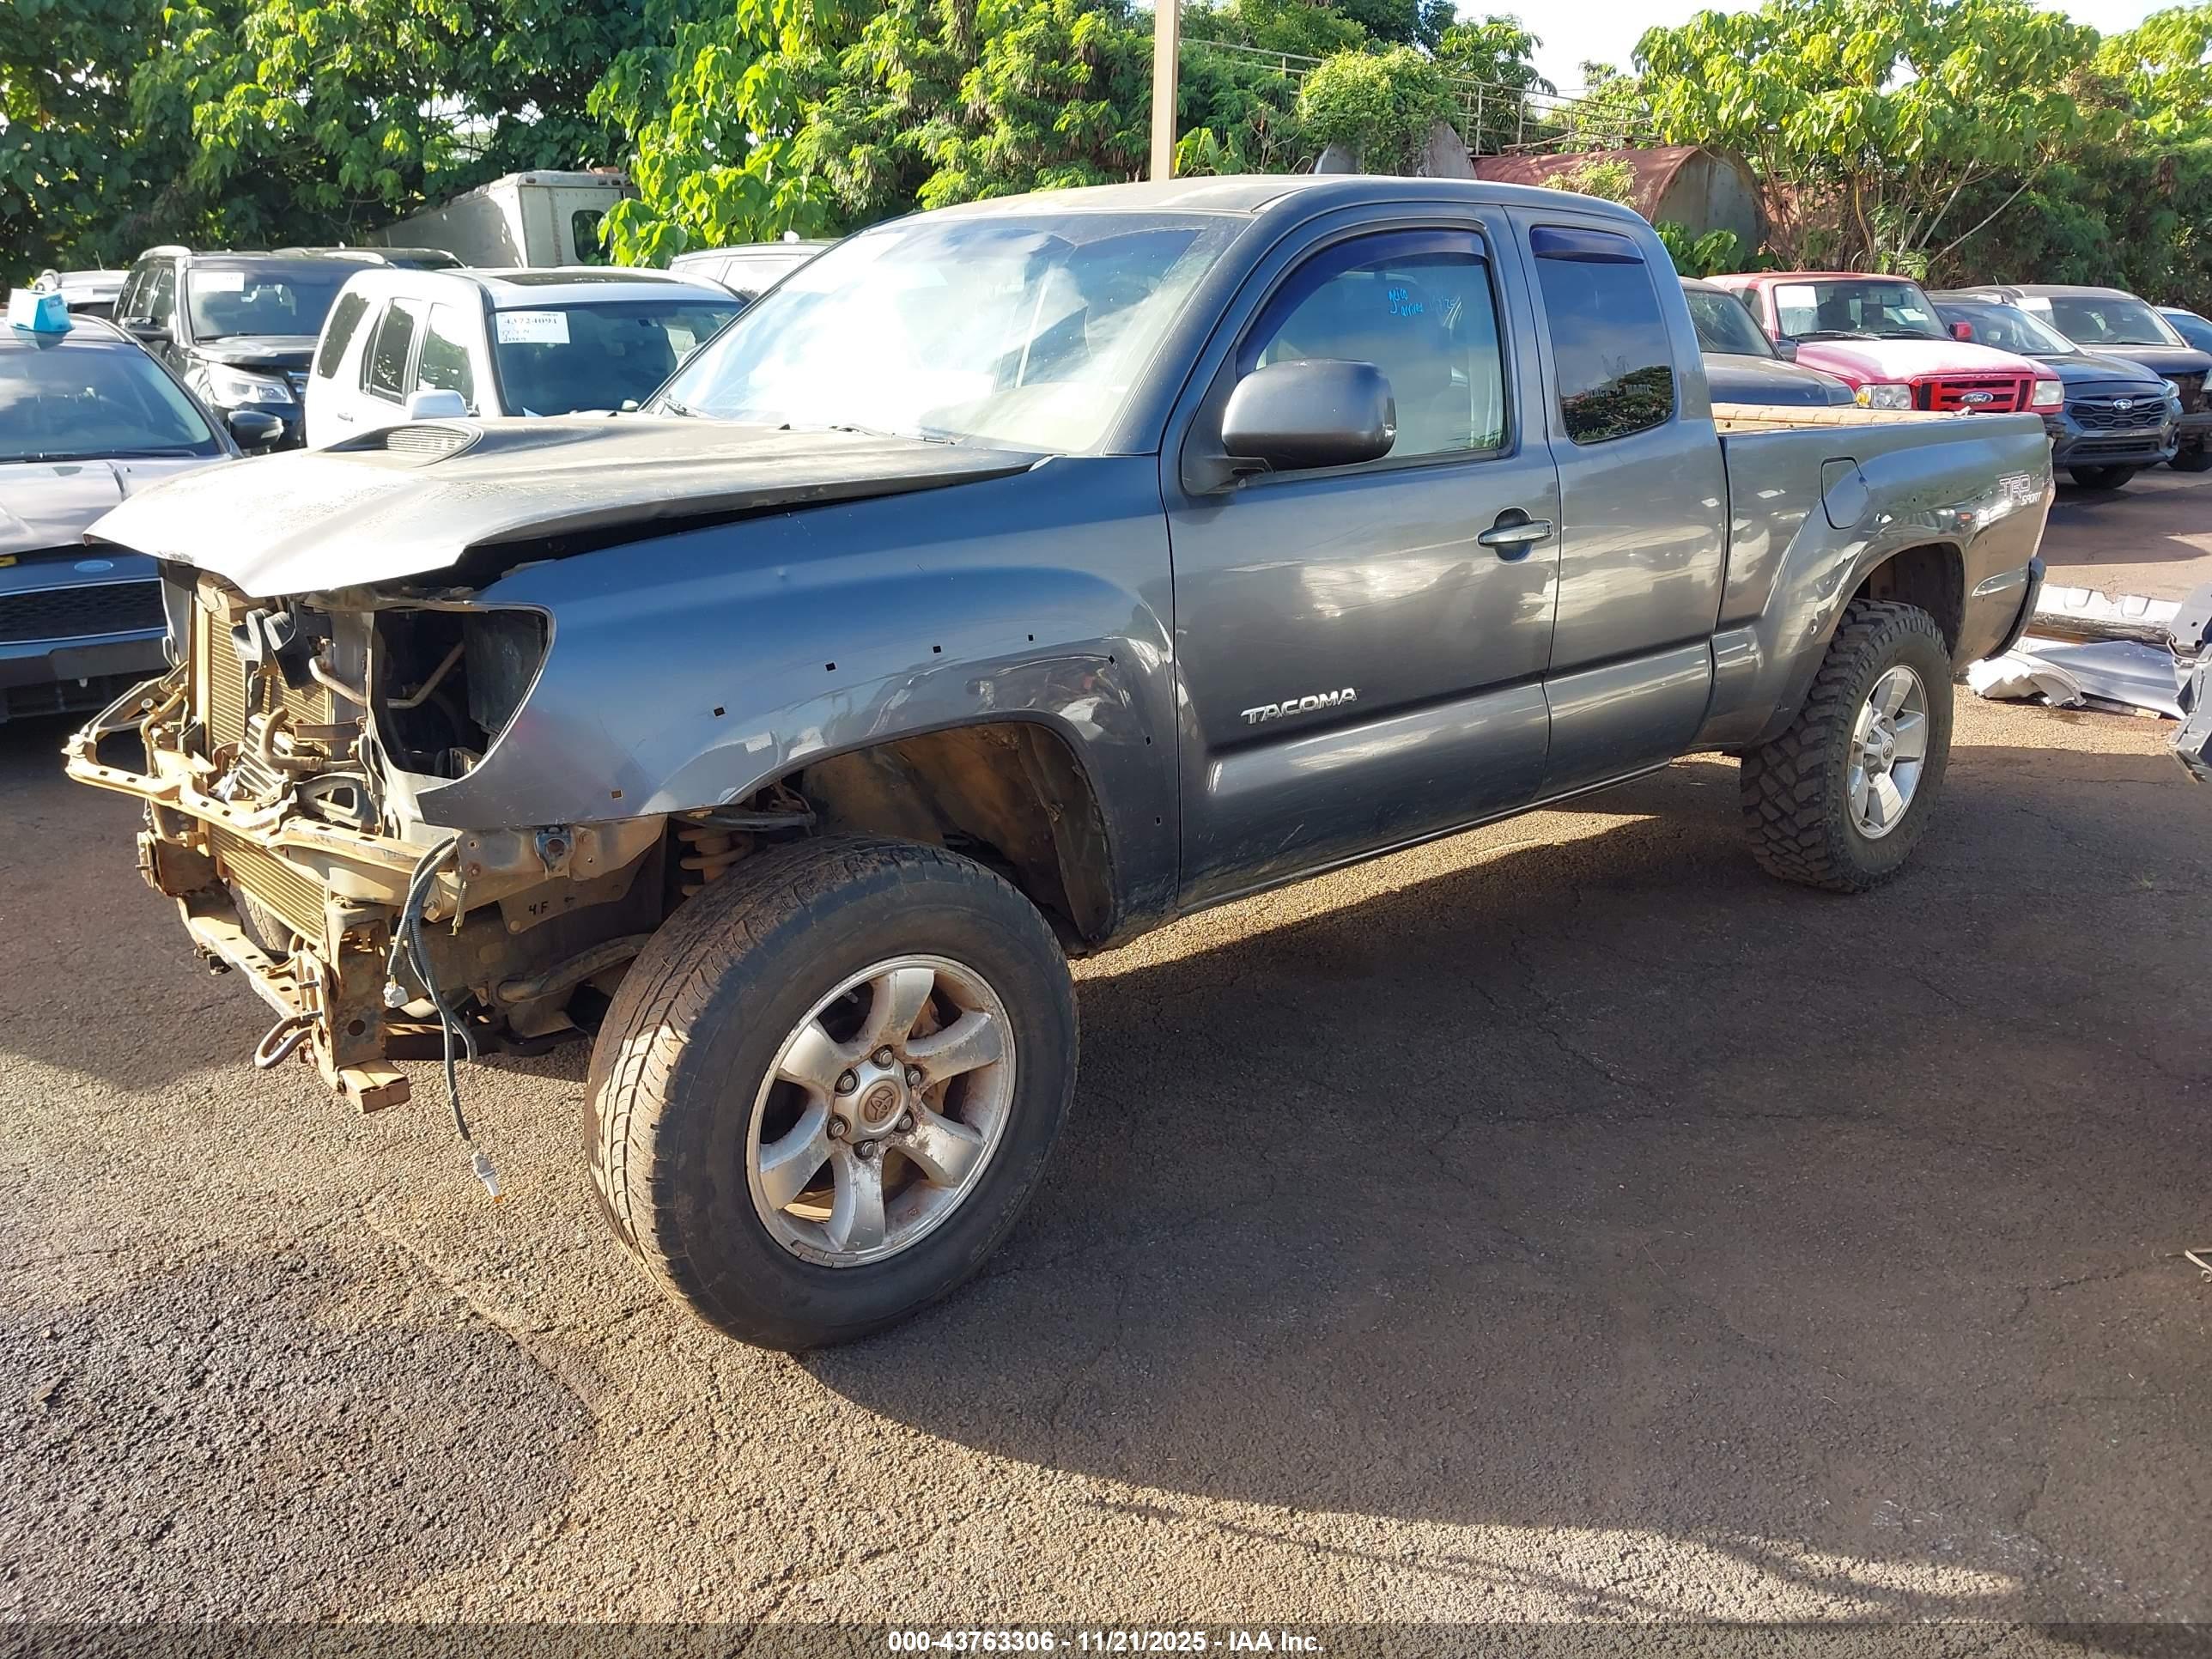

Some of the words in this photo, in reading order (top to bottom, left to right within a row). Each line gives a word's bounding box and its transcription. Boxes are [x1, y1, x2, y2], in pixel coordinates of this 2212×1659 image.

[1999, 474, 2031, 501] TRD
[2021, 491, 2043, 507] SPORT
[1240, 687, 1358, 725] TACOMA
